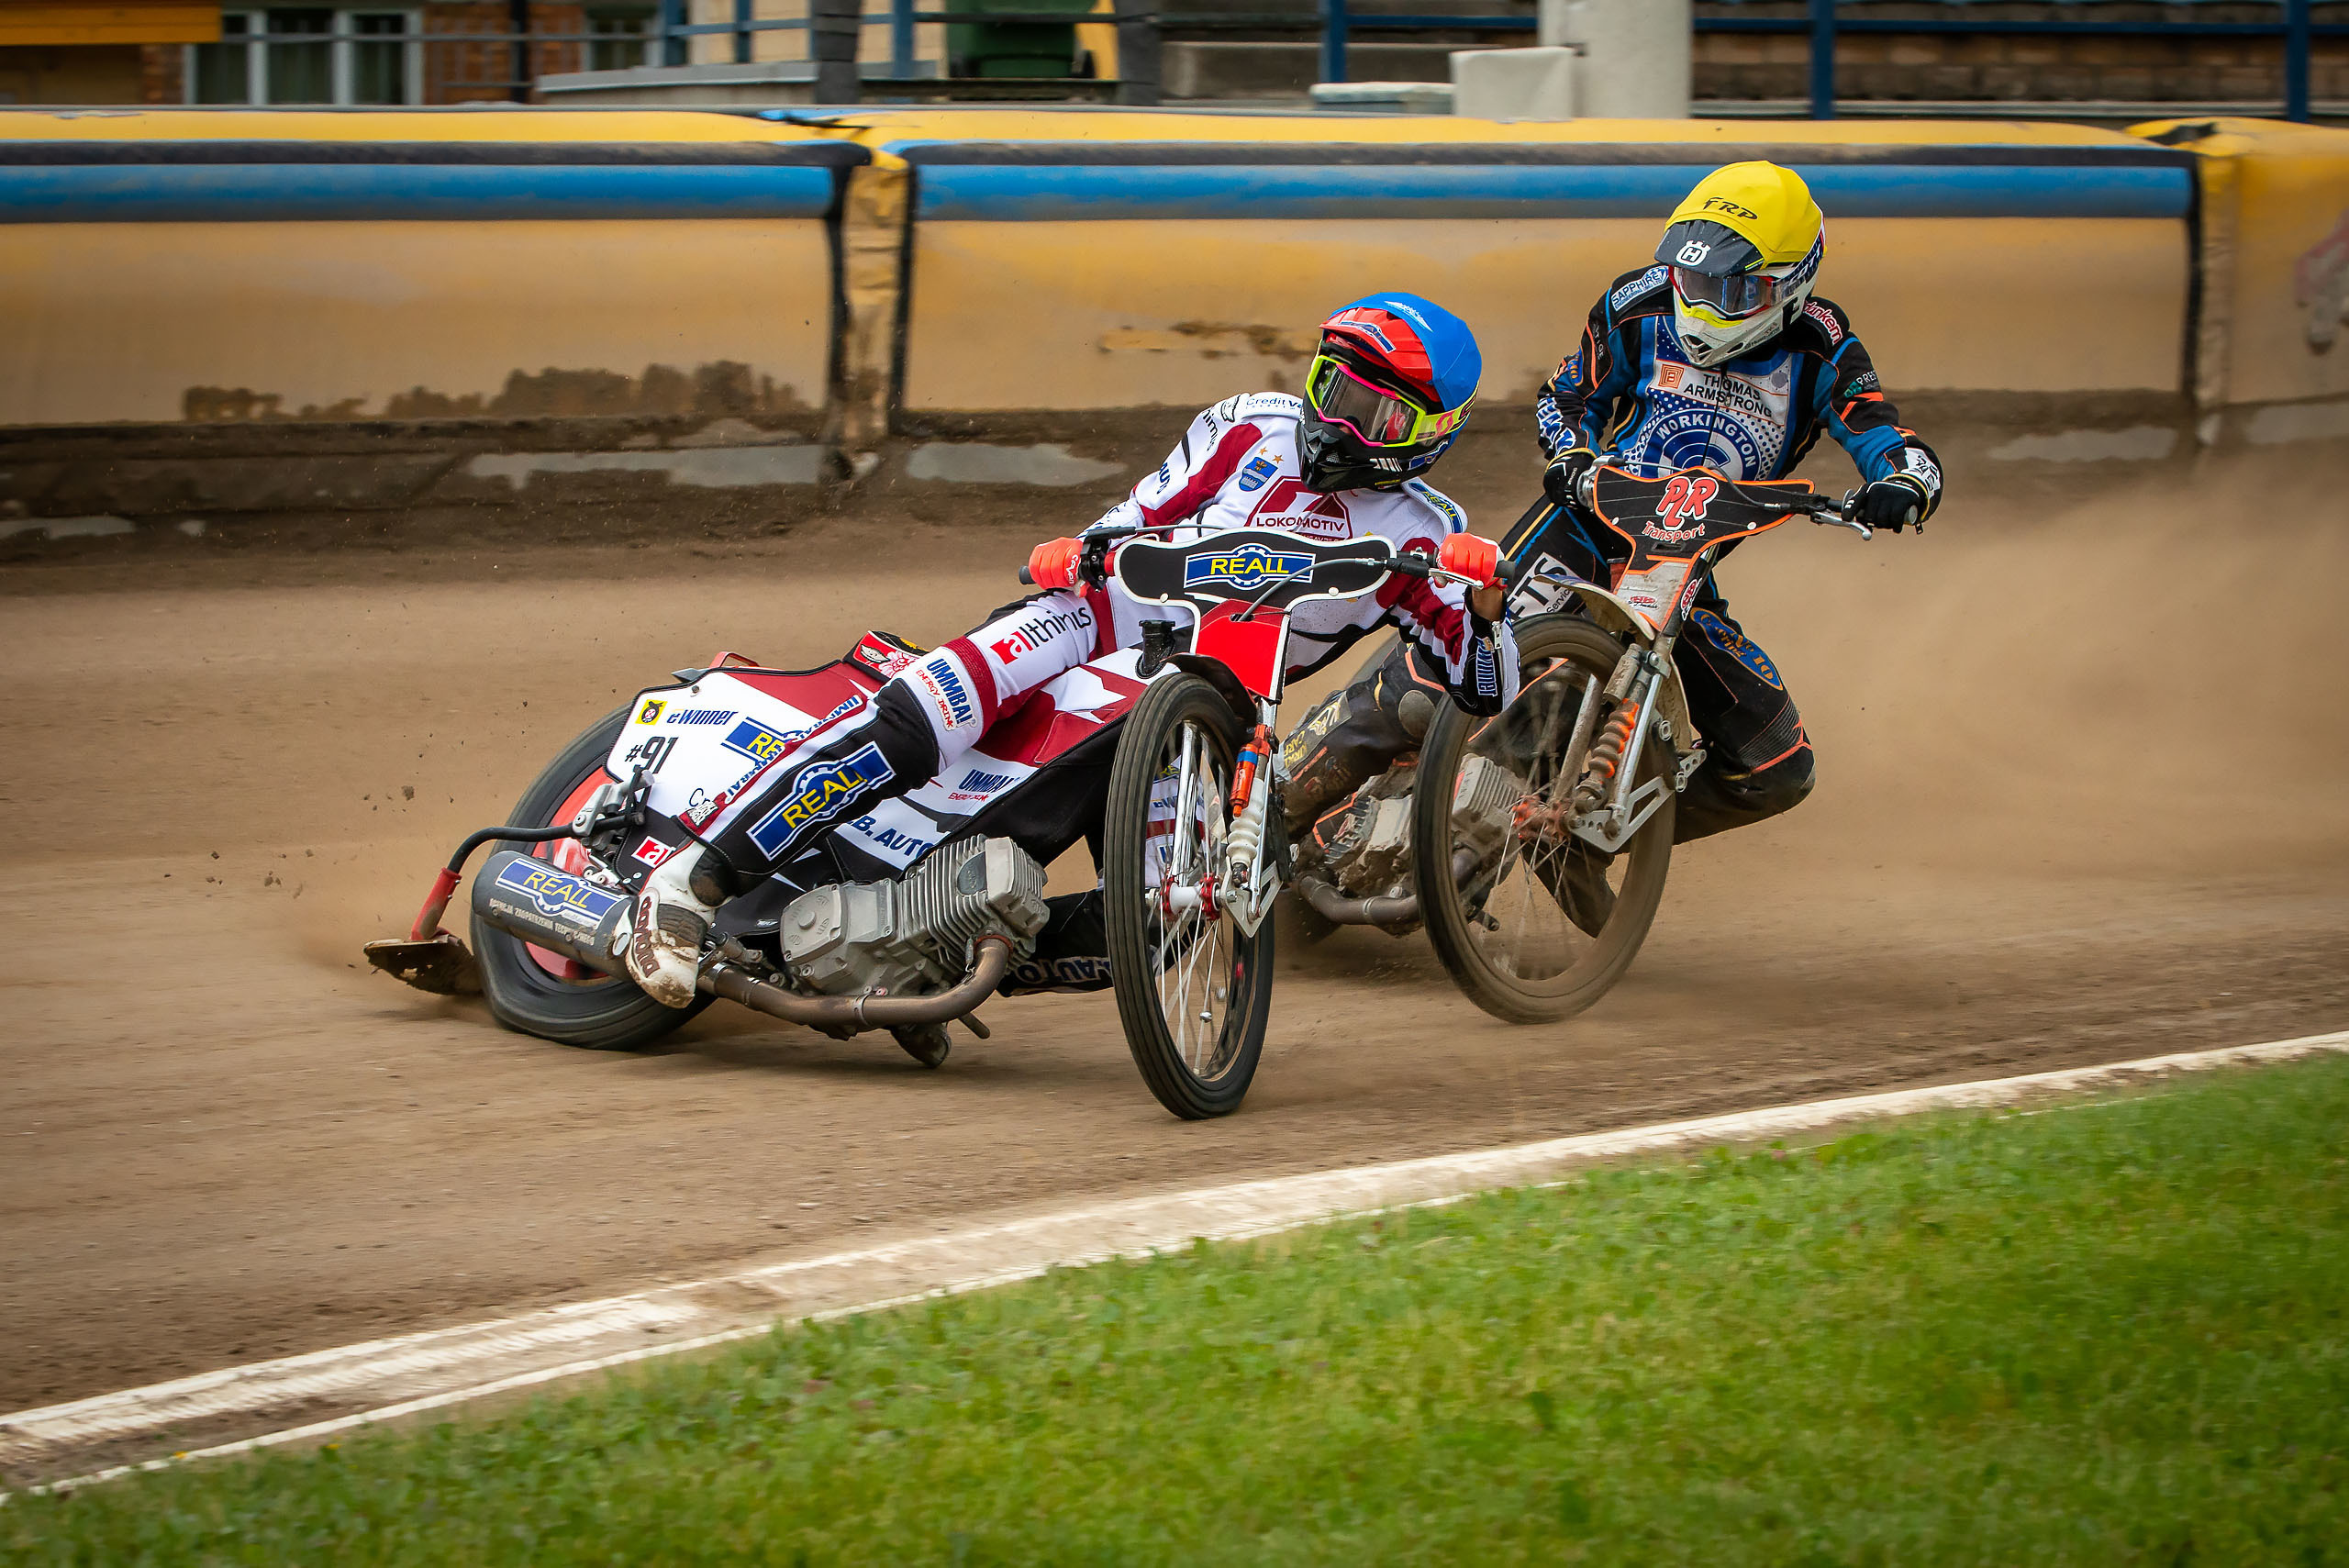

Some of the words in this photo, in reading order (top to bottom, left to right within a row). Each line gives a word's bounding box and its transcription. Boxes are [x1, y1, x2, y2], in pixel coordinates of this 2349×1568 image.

[1703, 196, 1758, 220] FRP
[1612, 272, 1661, 305] SAPPHIRE
[1684, 383, 1772, 417] ARMSTRONG
[1703, 373, 1761, 401] THOMAS
[1656, 413, 1756, 468] WORKINGTON
[1255, 517, 1345, 532] LOKOMOTIV
[1642, 521, 1706, 543] Transport
[1209, 557, 1289, 575] REALL
[1545, 588, 1572, 614] Servic
[916, 669, 941, 695] ENERGY
[938, 697, 954, 728] DRINK
[522, 871, 594, 909] REALL
